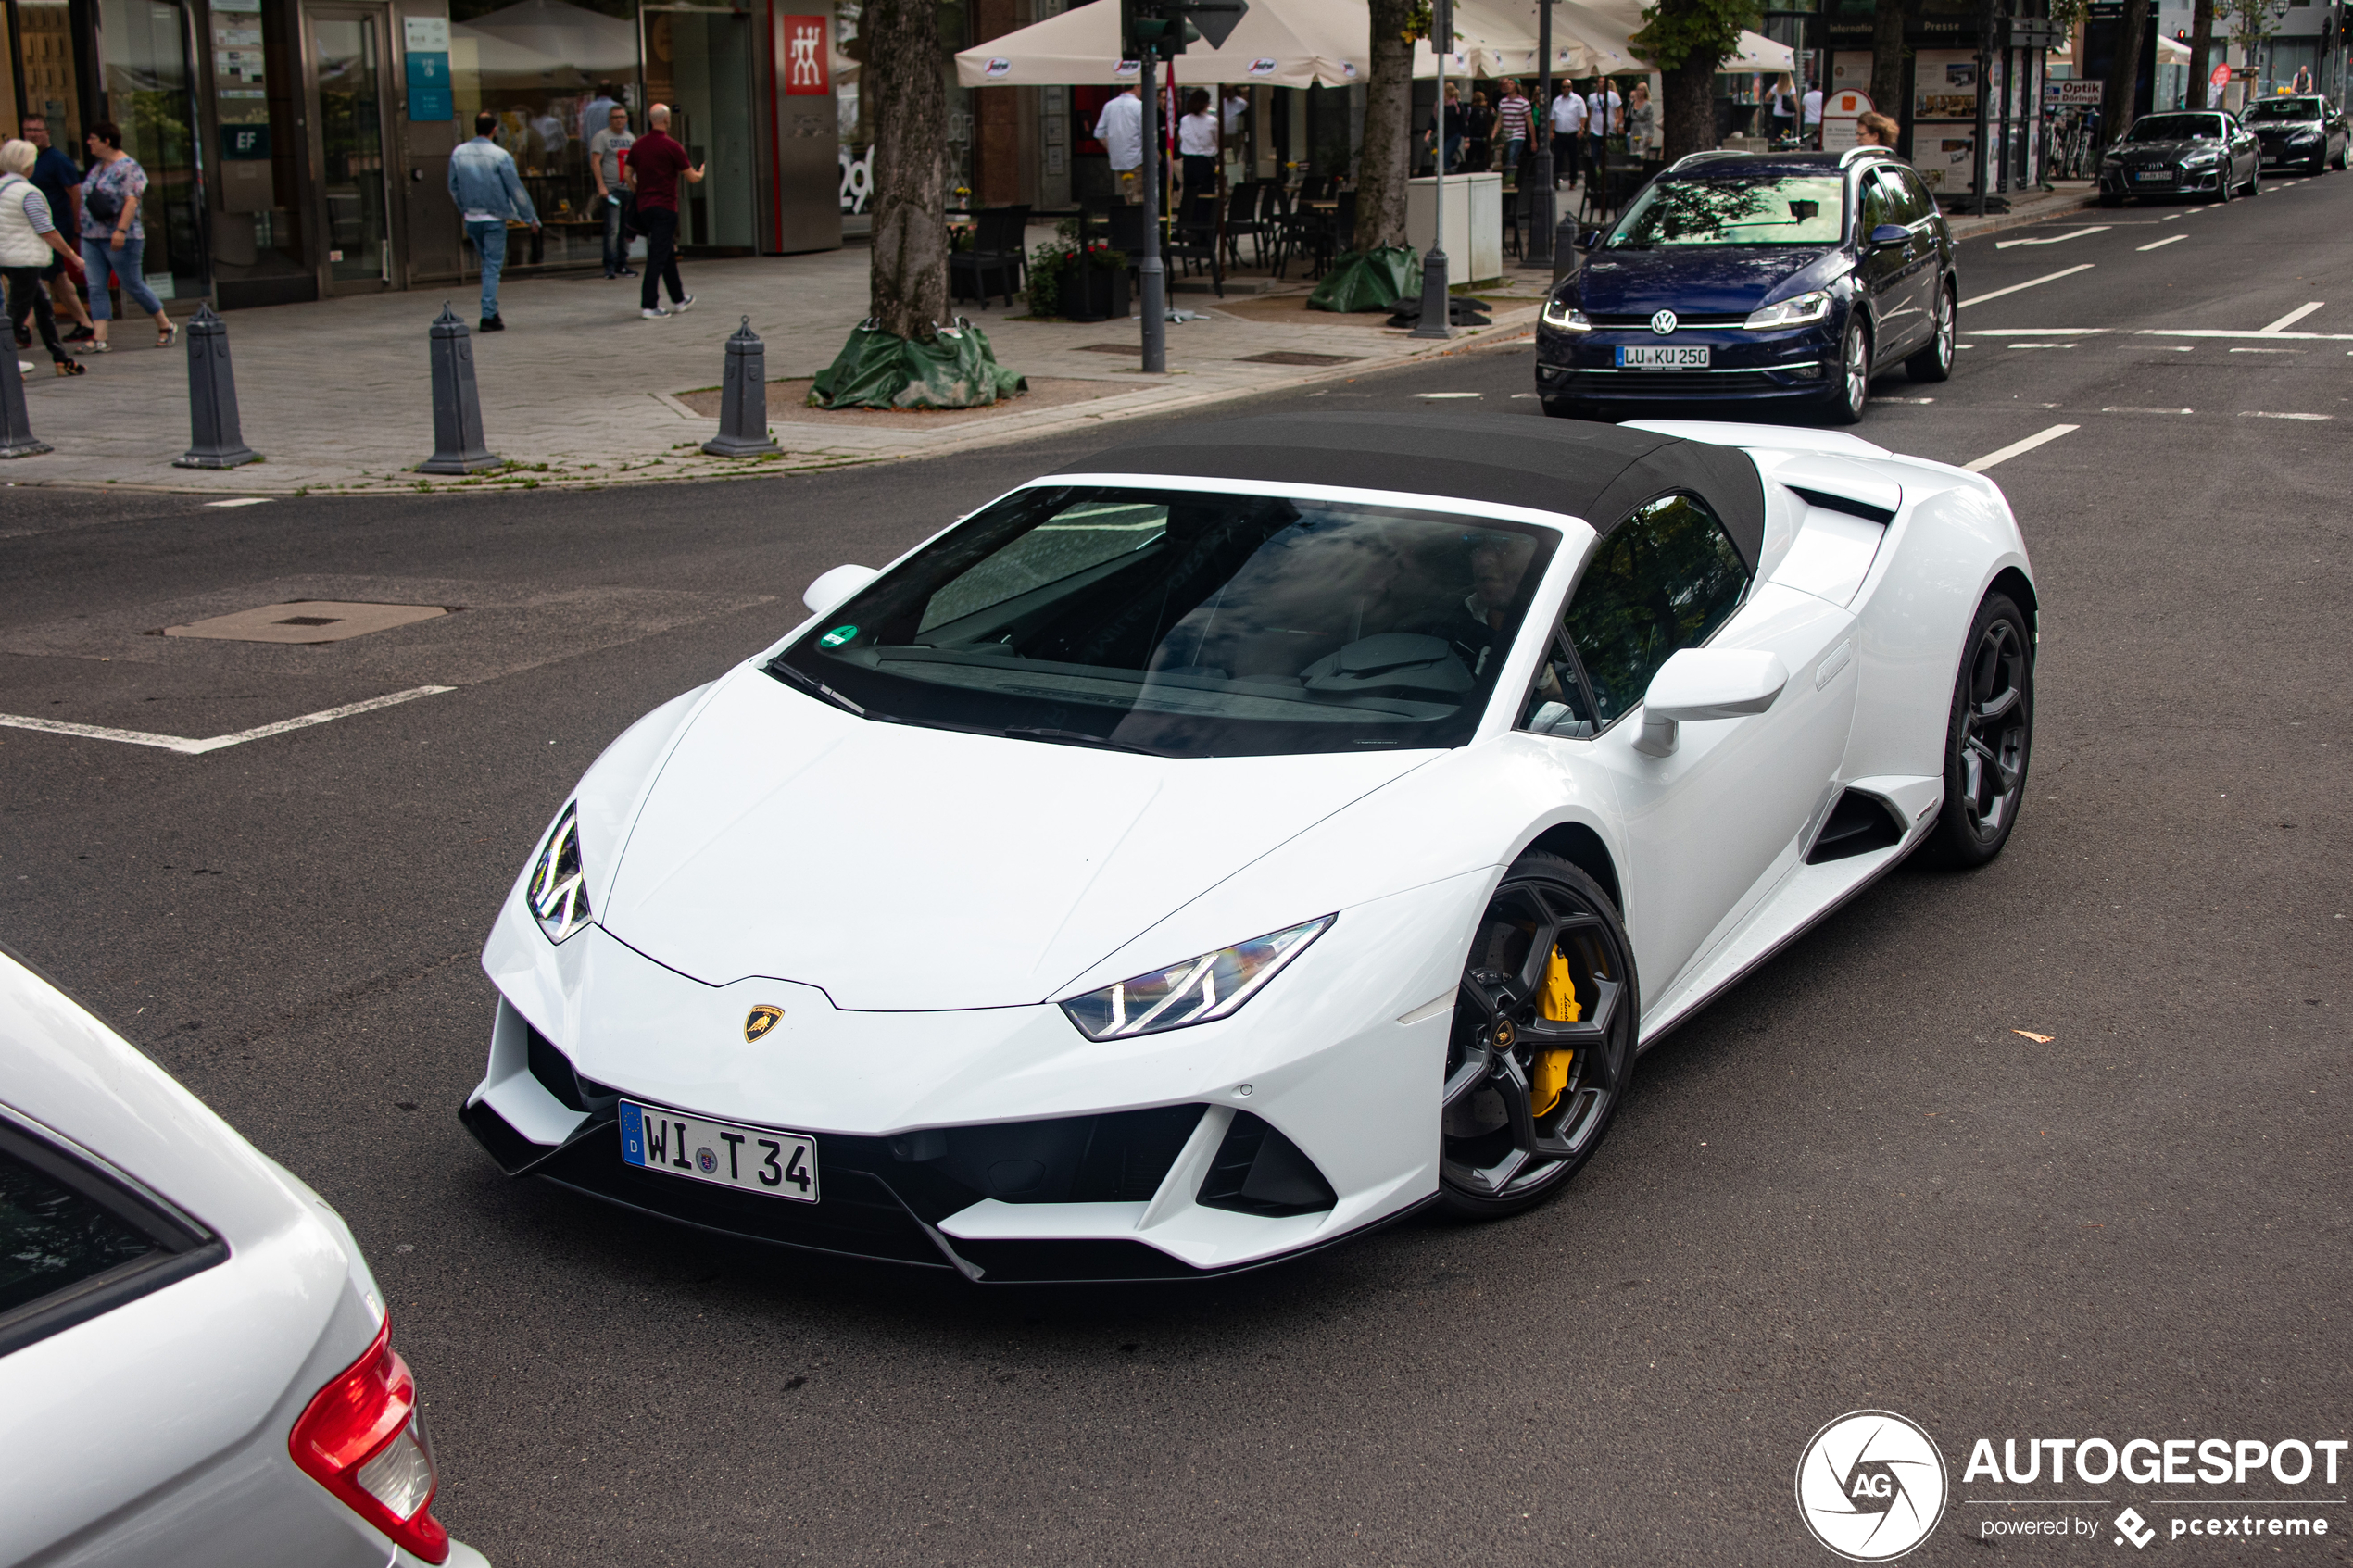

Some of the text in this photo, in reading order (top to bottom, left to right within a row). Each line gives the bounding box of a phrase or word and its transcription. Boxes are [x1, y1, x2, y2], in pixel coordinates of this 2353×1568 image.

[1923, 20, 1960, 31] Presse
[2063, 82, 2099, 94] Optik
[237, 132, 257, 149] EF
[1625, 349, 1645, 364] LU
[1655, 349, 1675, 364] KU
[1679, 349, 1707, 364] 250
[629, 1114, 811, 1193] D WI T 34
